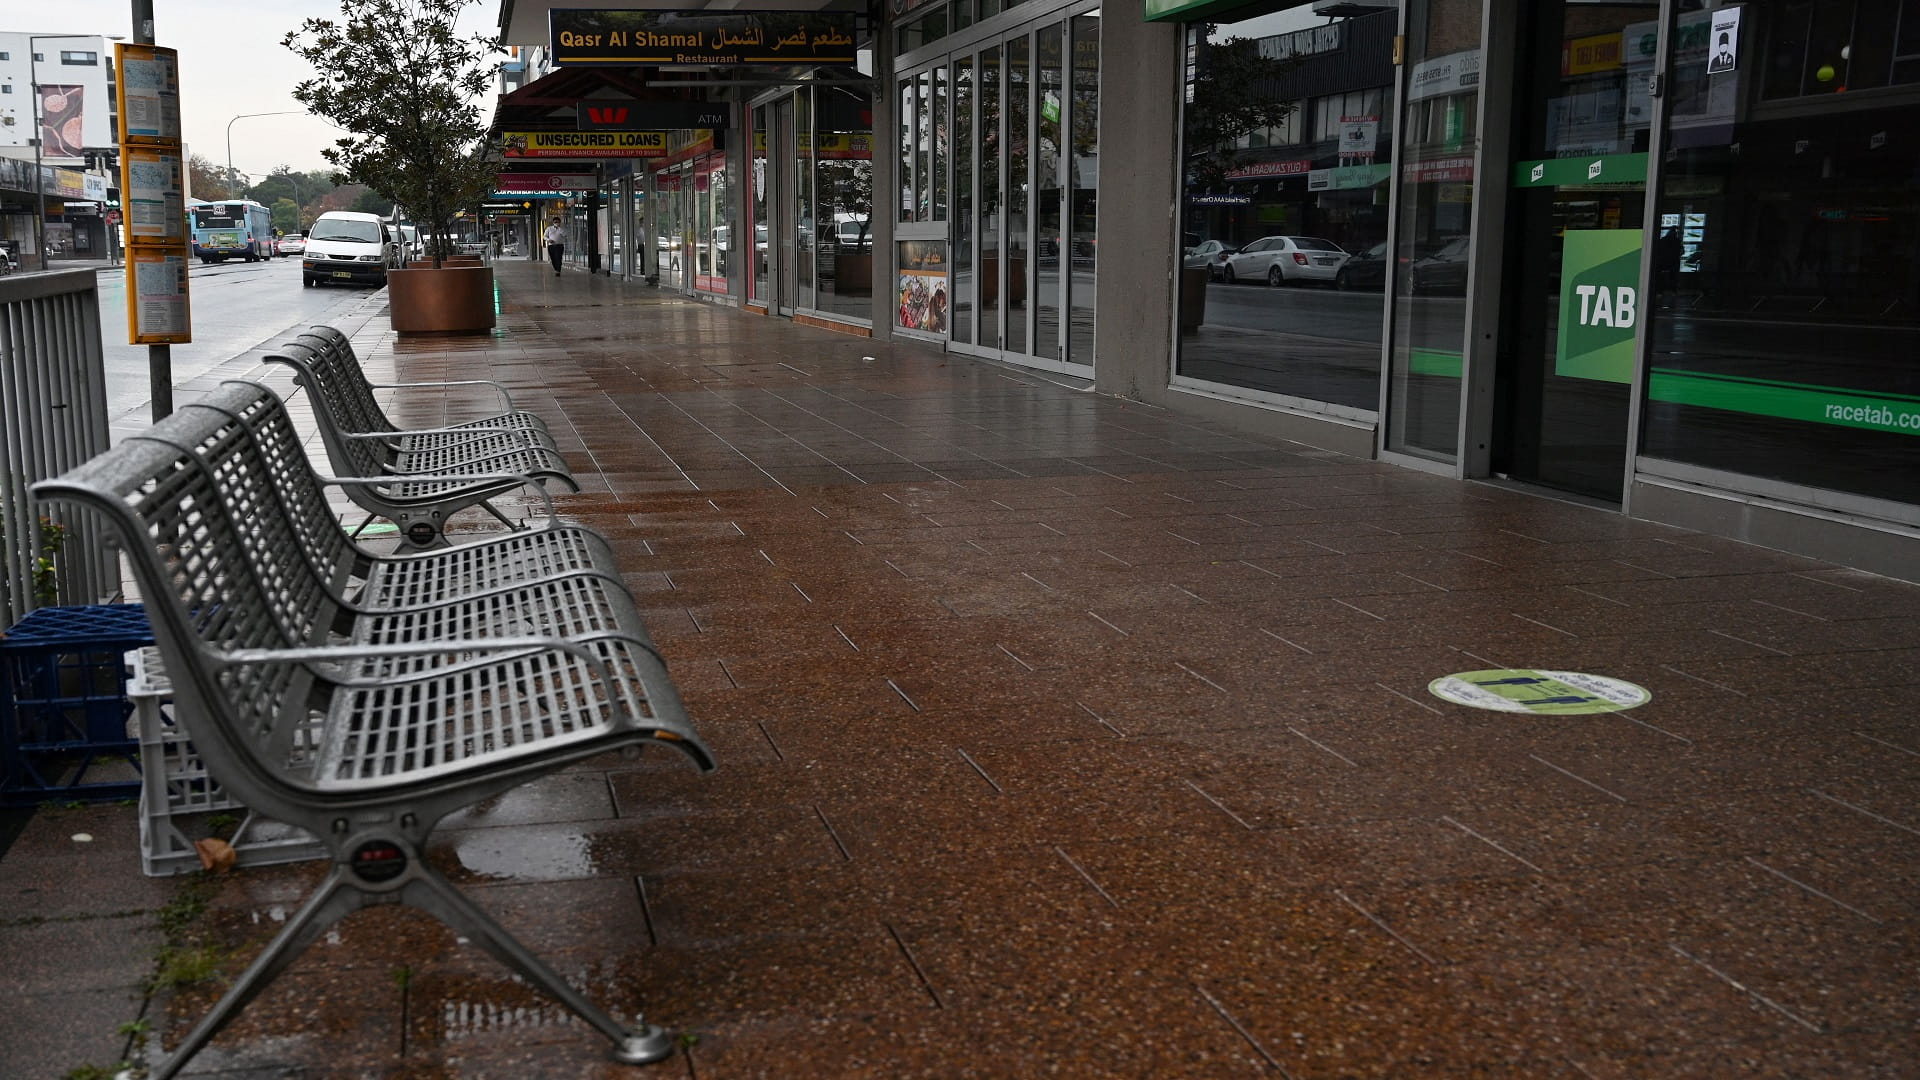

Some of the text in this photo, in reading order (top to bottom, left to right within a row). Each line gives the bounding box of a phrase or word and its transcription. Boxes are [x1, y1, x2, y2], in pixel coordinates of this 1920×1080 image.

[560, 31, 703, 49] Qasr Al Shamal
[711, 25, 852, 54] مطعم قصر الشمال
[677, 53, 738, 63] Restaurant
[698, 114, 723, 125] ATM
[536, 133, 615, 147] UNSECURED
[620, 133, 661, 146] LOANS
[1533, 169, 1542, 177] TAB
[1590, 166, 1601, 174] TAB
[1576, 285, 1636, 329] TAB
[1825, 404, 1920, 430] racetab.co
